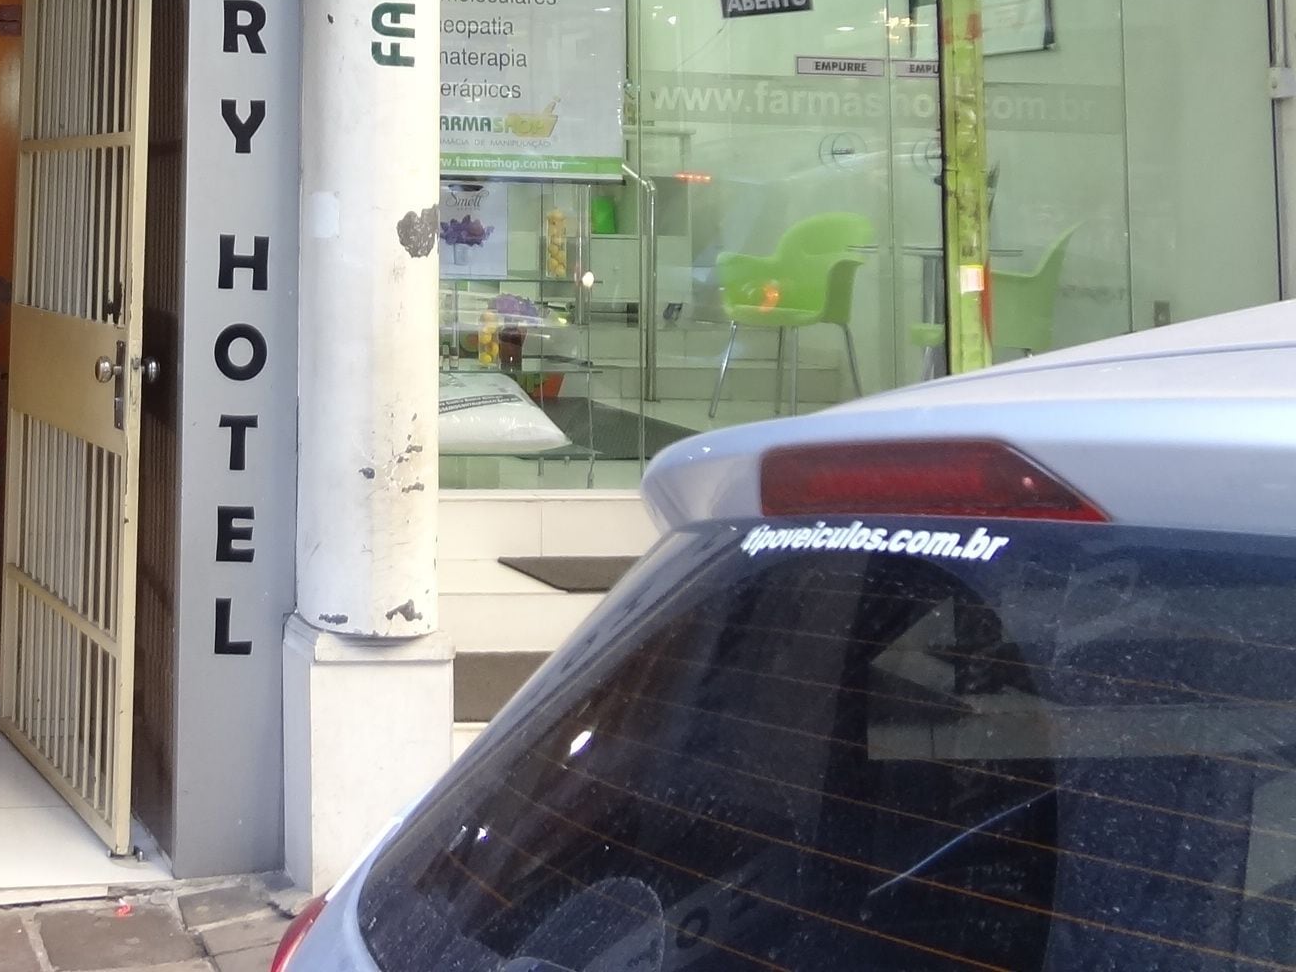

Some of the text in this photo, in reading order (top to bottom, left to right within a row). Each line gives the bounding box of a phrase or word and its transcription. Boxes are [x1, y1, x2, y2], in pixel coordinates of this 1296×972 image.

[440, 16, 514, 38] eopatia
[814, 61, 868, 73] EMPURRE
[213, 233, 270, 656] HOTEL
